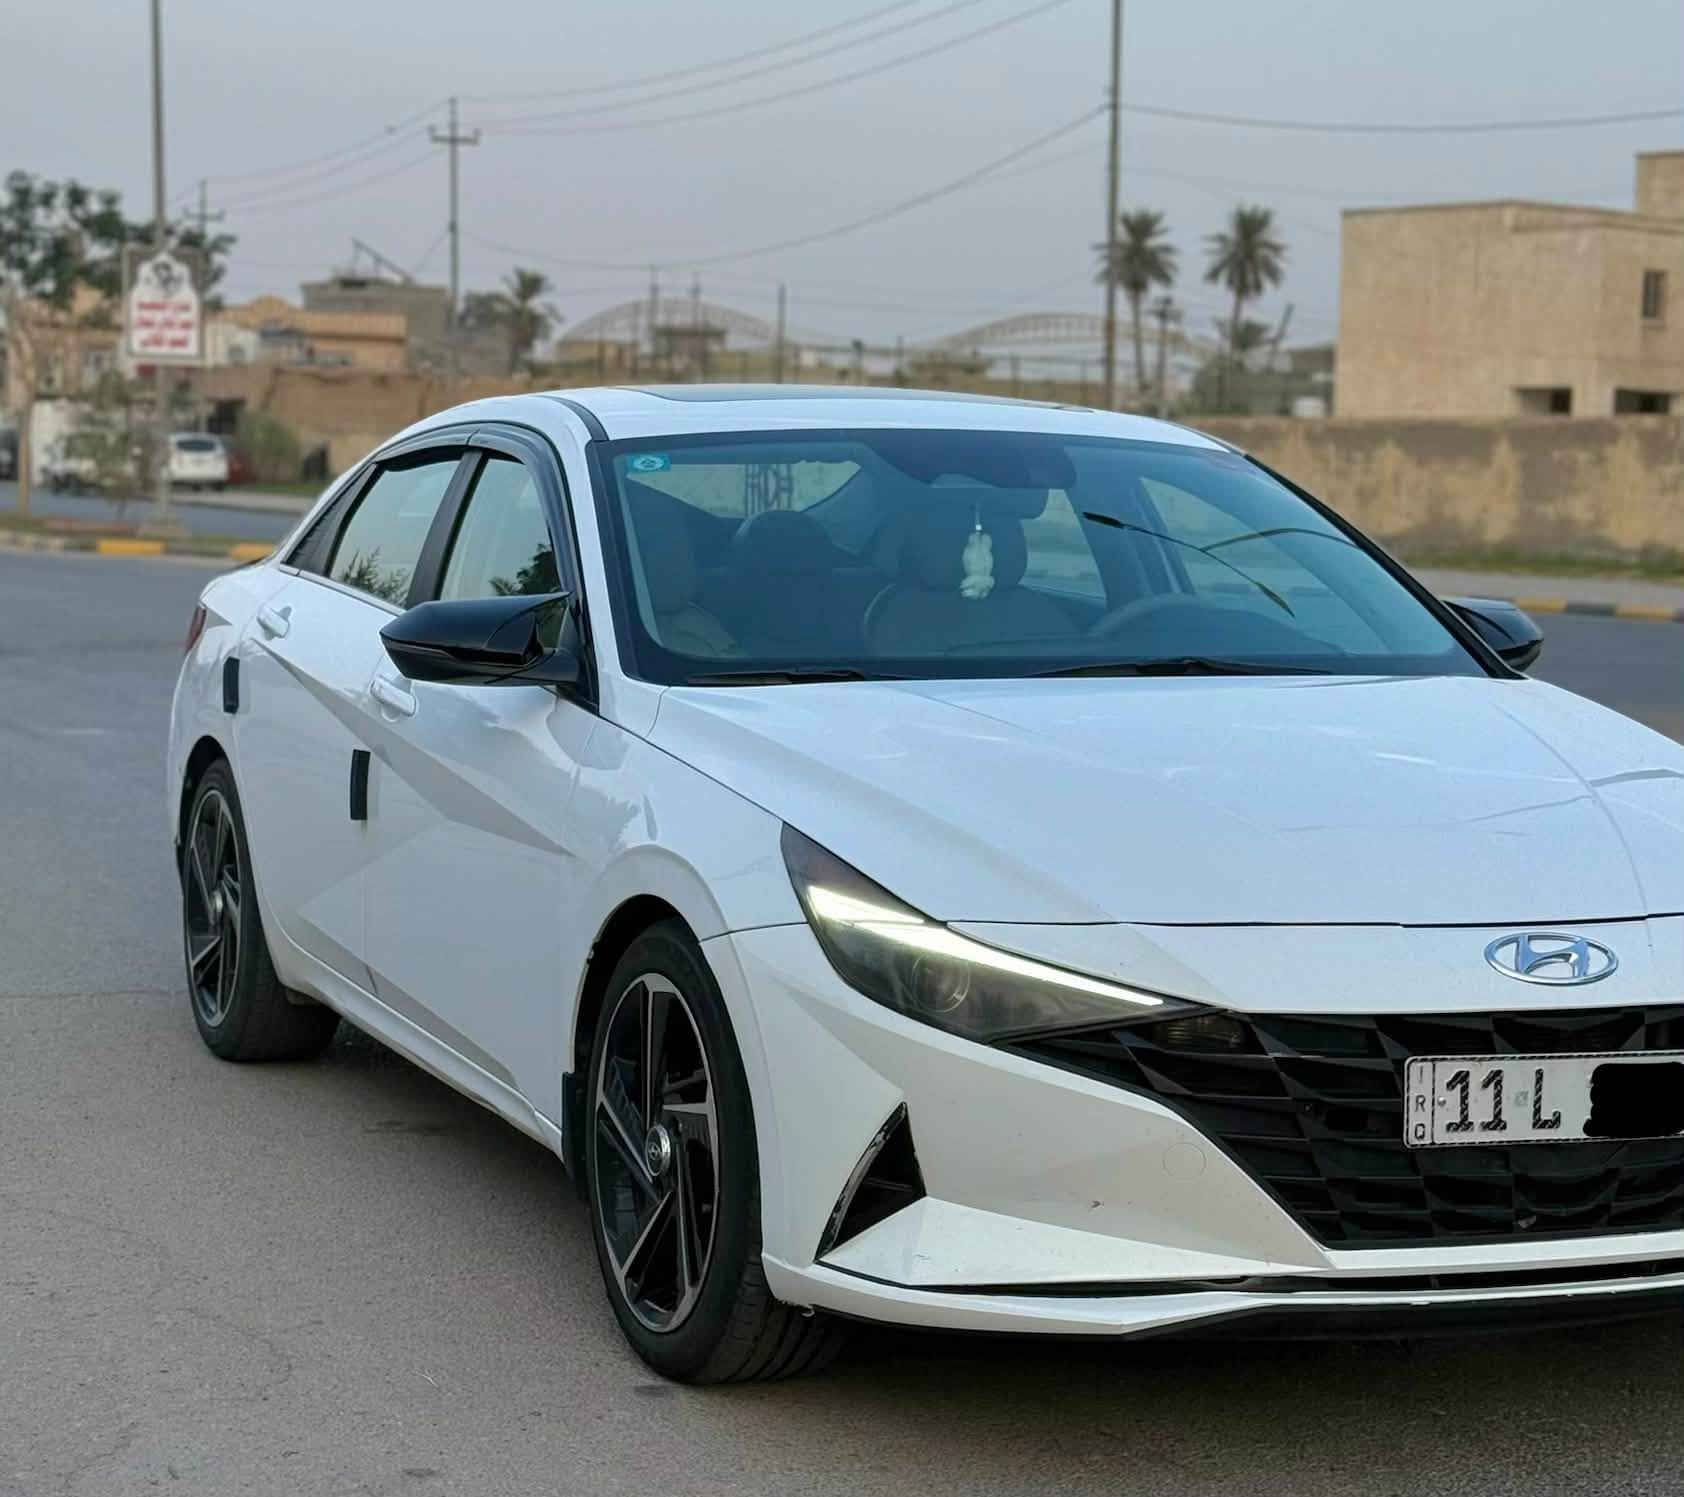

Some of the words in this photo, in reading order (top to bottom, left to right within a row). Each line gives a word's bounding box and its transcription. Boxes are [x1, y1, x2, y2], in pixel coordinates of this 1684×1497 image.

[1414, 1065, 1426, 1140] IRQ
[1446, 1069, 1508, 1132] 11
[1532, 1068, 1562, 1129] L
